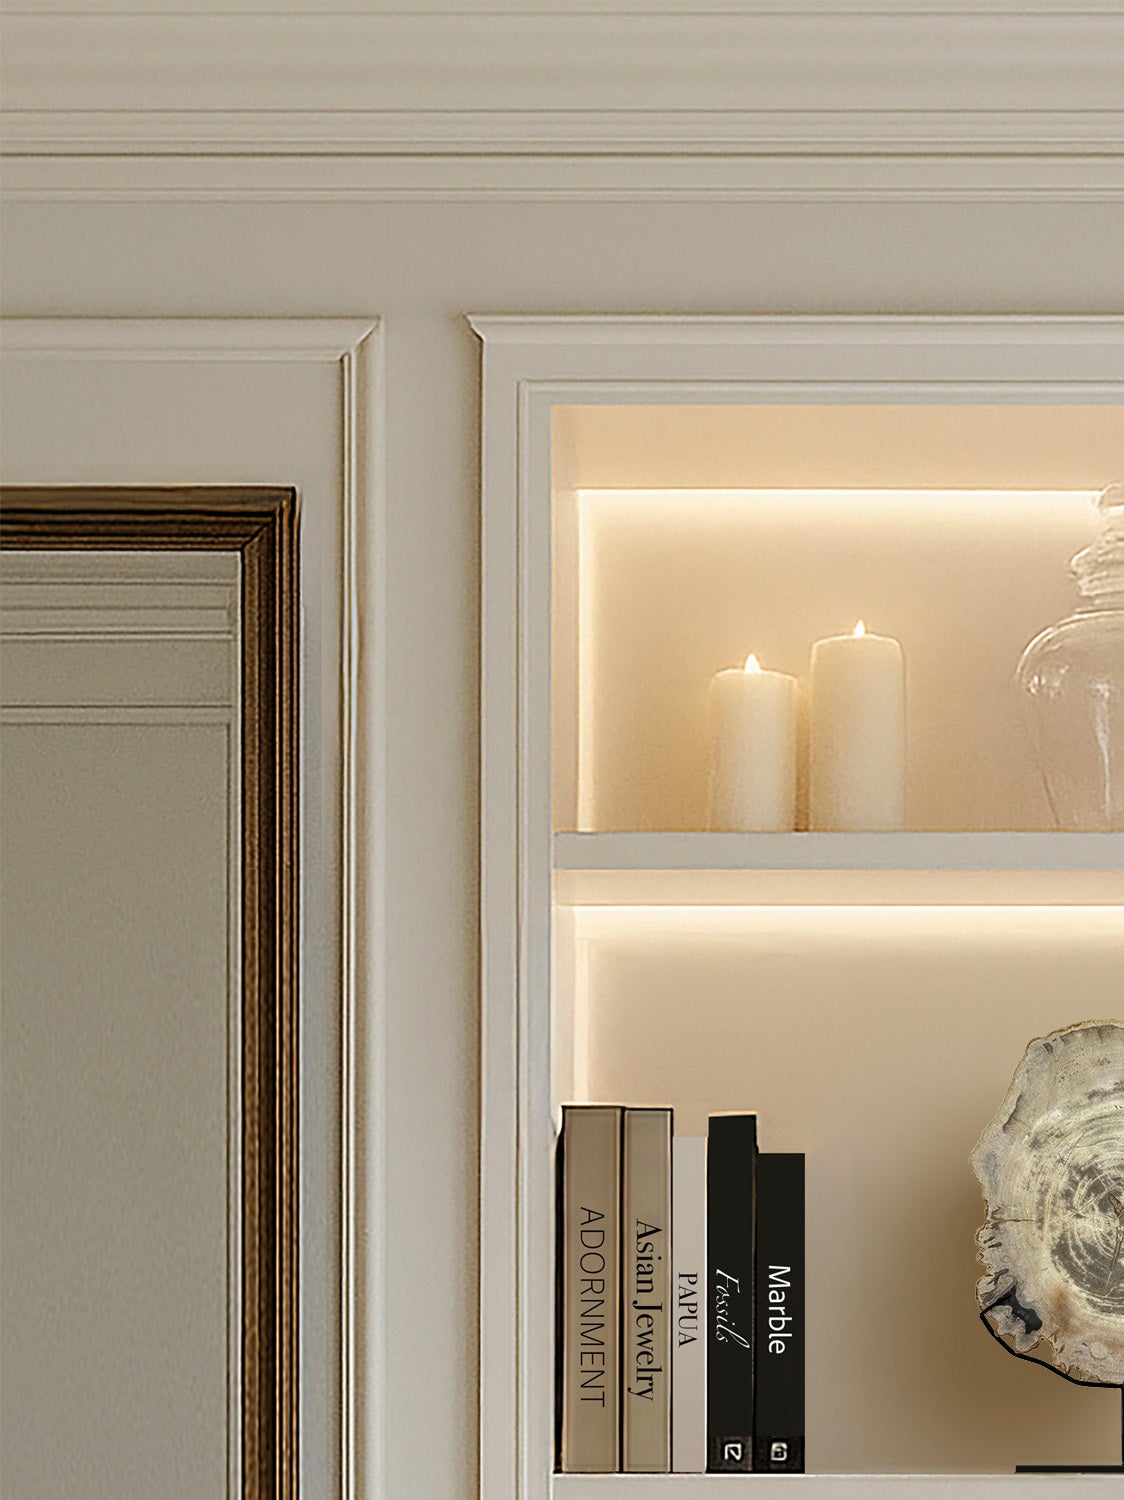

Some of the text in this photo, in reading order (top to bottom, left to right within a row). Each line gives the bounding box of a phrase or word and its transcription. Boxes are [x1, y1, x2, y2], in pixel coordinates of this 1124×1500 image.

[579, 1206, 605, 1408] ADORNMENT
[627, 1218, 663, 1401] Asian Jewelry
[678, 1272, 698, 1348] PAPUA
[715, 1268, 751, 1349] Fossils
[768, 1264, 793, 1355] Marble
